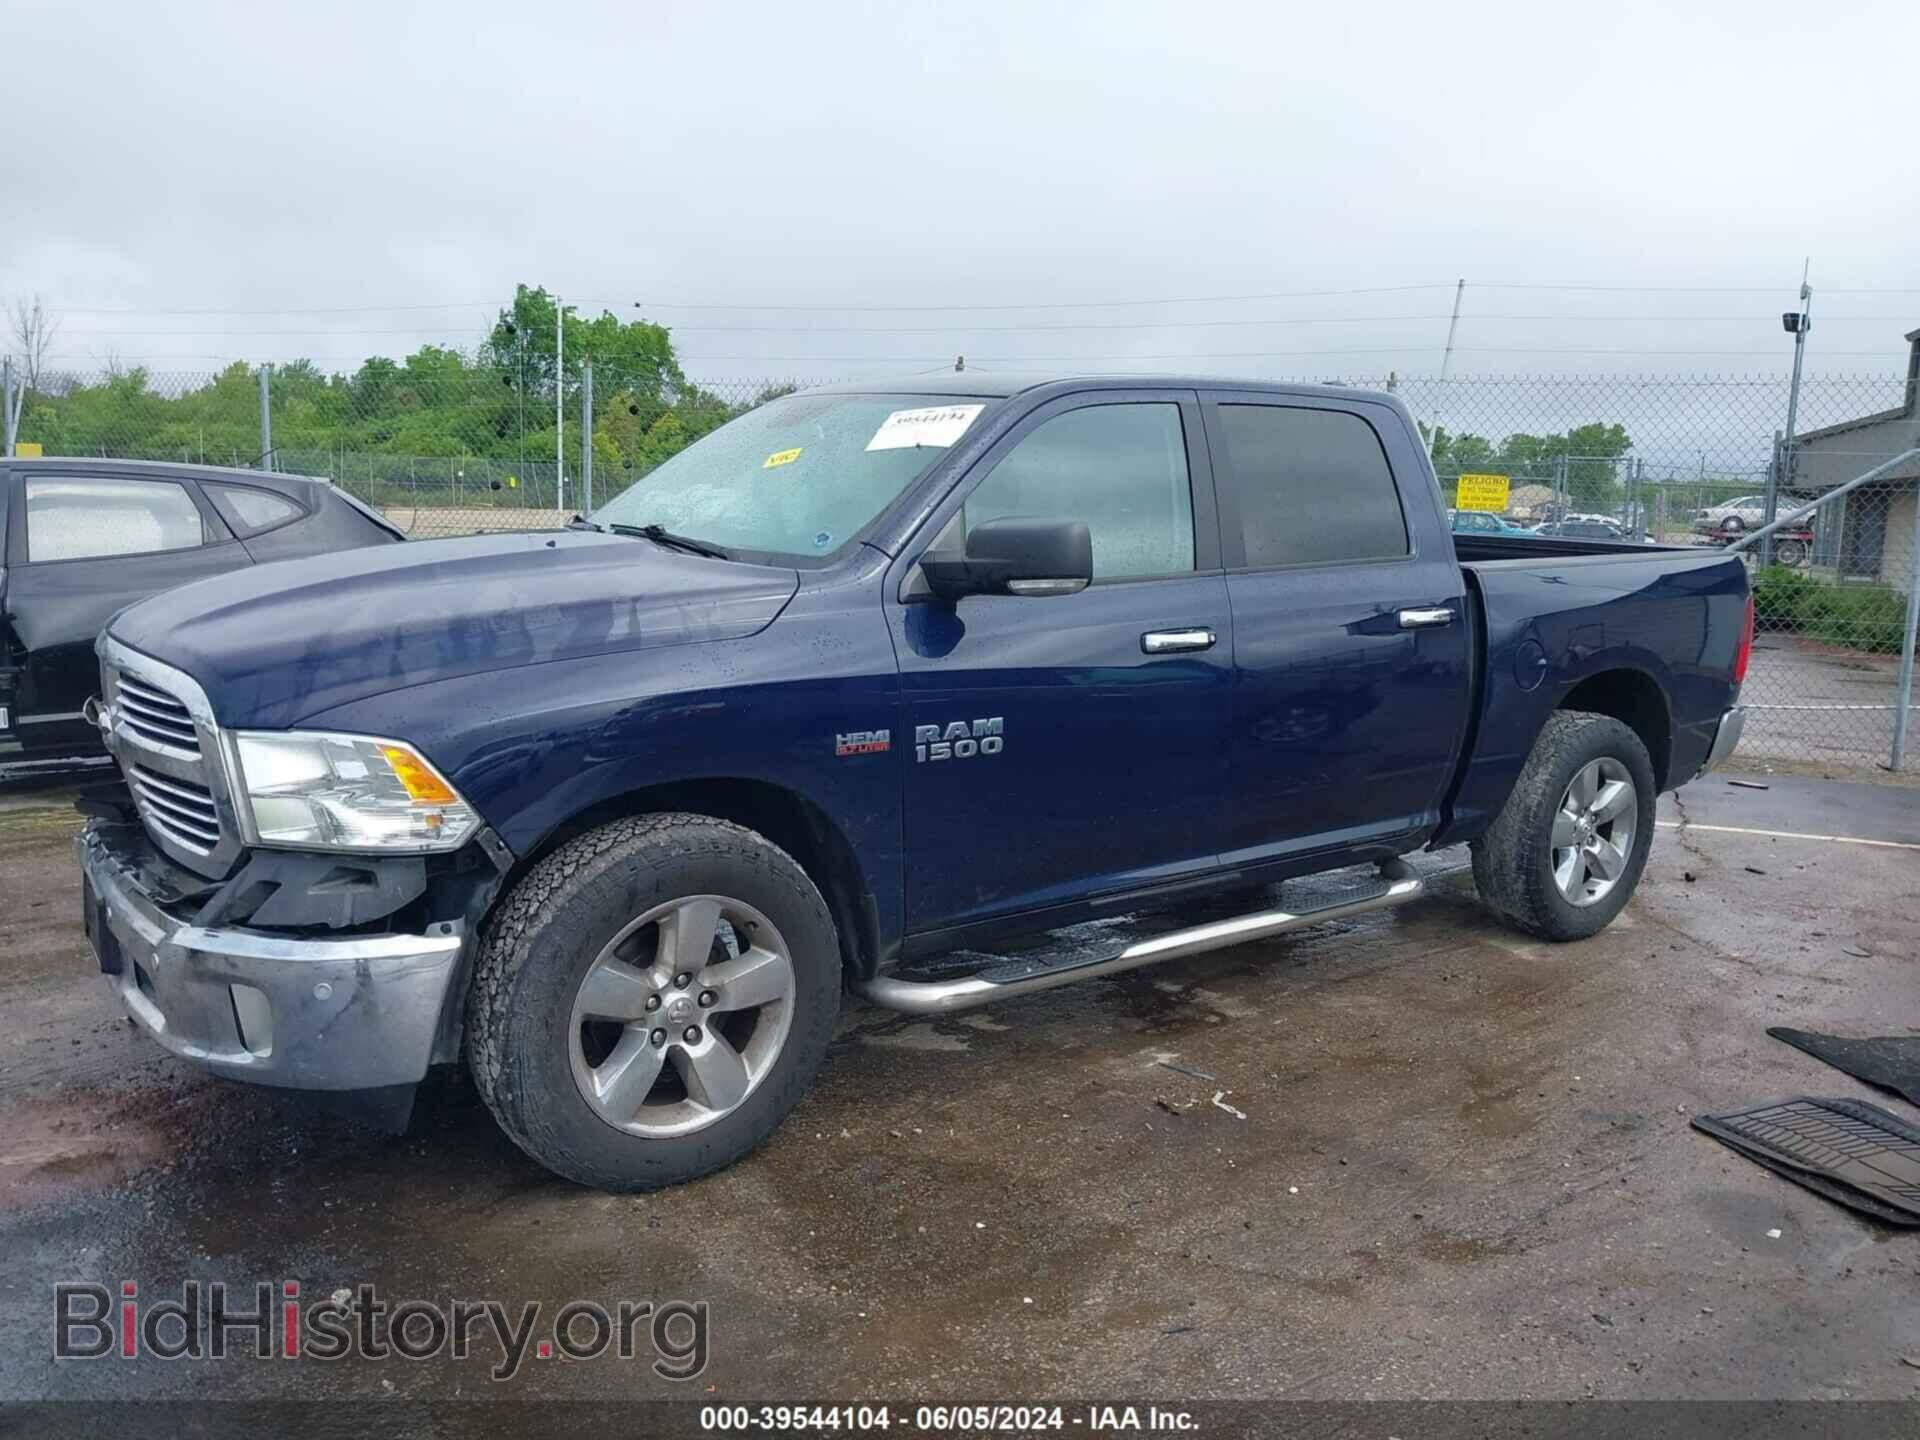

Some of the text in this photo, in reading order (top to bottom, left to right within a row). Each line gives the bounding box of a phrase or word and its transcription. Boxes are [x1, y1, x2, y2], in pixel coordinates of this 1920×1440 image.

[836, 729, 890, 746] HEMI
[915, 717, 1004, 744] RAM
[915, 737, 1004, 763] 1500
